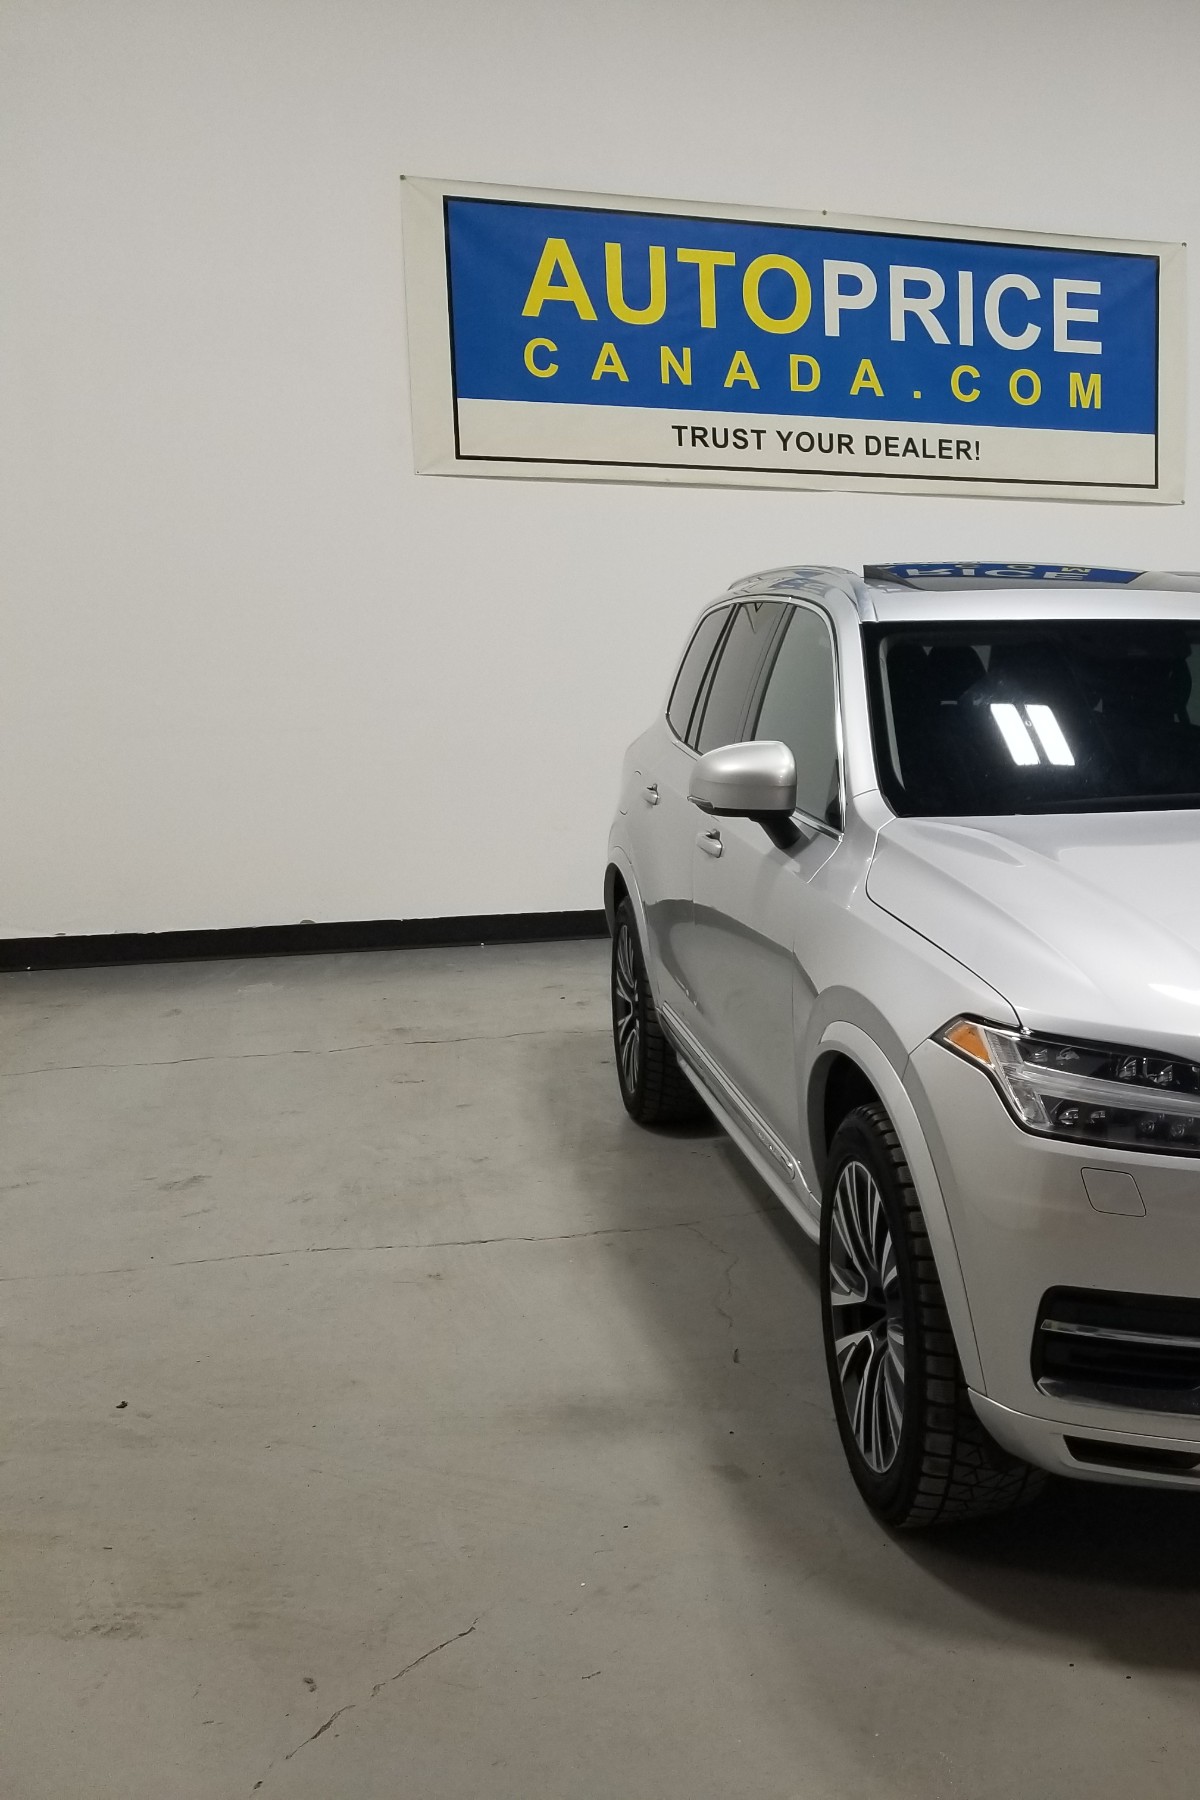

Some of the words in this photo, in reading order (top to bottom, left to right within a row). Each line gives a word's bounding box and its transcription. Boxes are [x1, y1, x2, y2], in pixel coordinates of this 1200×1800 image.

[521, 237, 1102, 355] AUTOPRICE
[523, 337, 1102, 409] CANADA.COM
[671, 425, 767, 451] TRUST
[775, 430, 855, 455] YOUR
[865, 435, 980, 461] DEALER!
